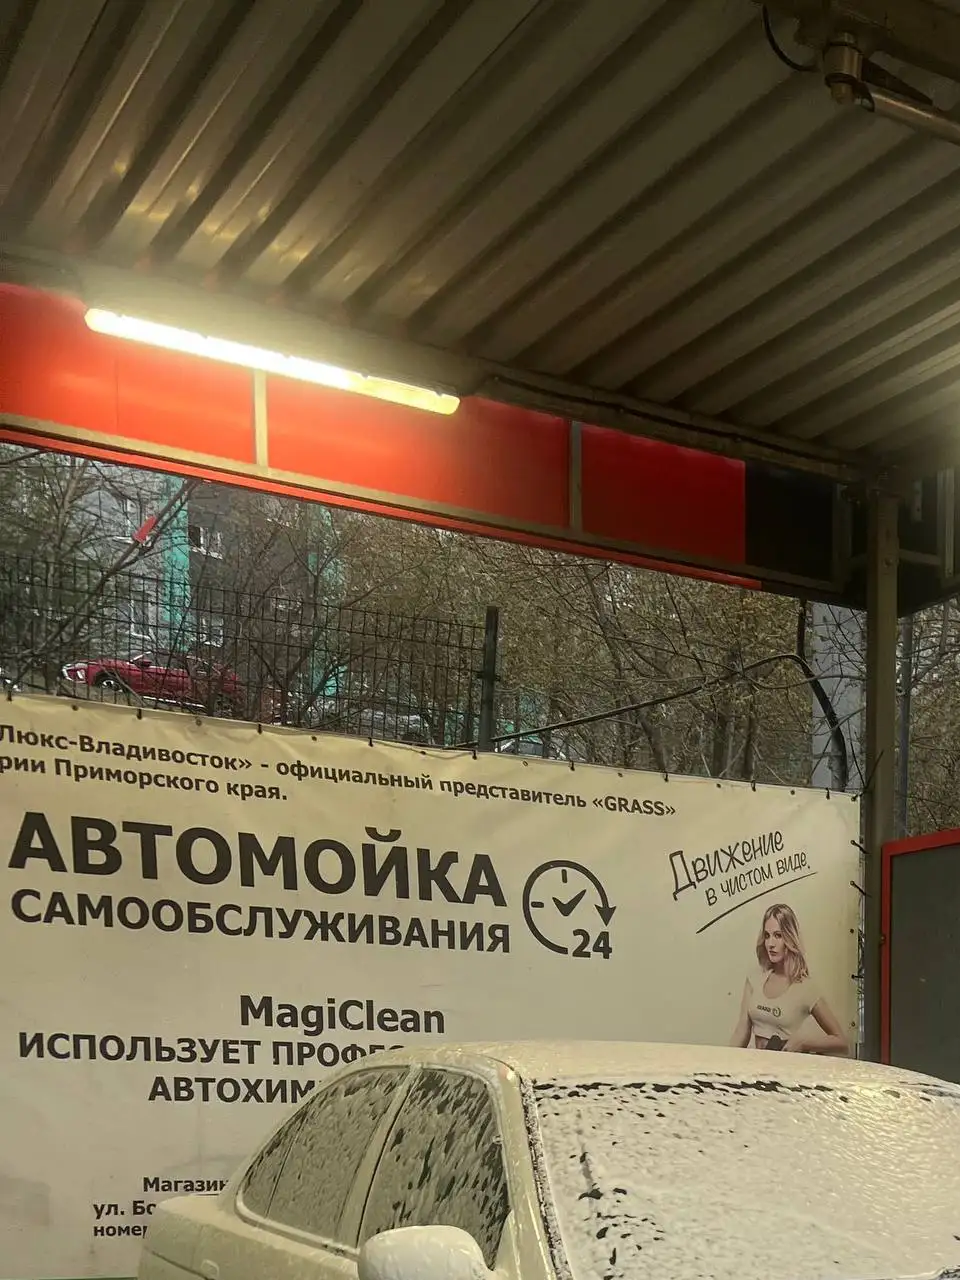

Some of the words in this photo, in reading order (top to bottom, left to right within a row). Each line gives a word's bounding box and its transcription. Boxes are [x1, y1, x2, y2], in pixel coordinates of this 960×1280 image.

[0, 724, 253, 772] Люкс-Владивосток»
[276, 759, 433, 791] официальный
[439, 779, 587, 808] представитель
[592, 795, 676, 817] «GRASS»
[55, 758, 220, 794] Приморского
[227, 780, 288, 801] края.
[7, 811, 507, 908] АВТОМОЙКА
[669, 830, 784, 901] Движение
[776, 851, 811, 875] виде.
[11, 888, 511, 955] САМООБСЛУЖИВАНИЯ
[572, 928, 613, 960] 24
[240, 995, 445, 1037] MagiClean
[18, 1031, 261, 1066] ИСПОЛЬЗУЕТ
[272, 1041, 405, 1067] ПРОФ
[148, 1075, 322, 1104] АВТОХИМ
[93, 1203, 125, 1220] ул.
